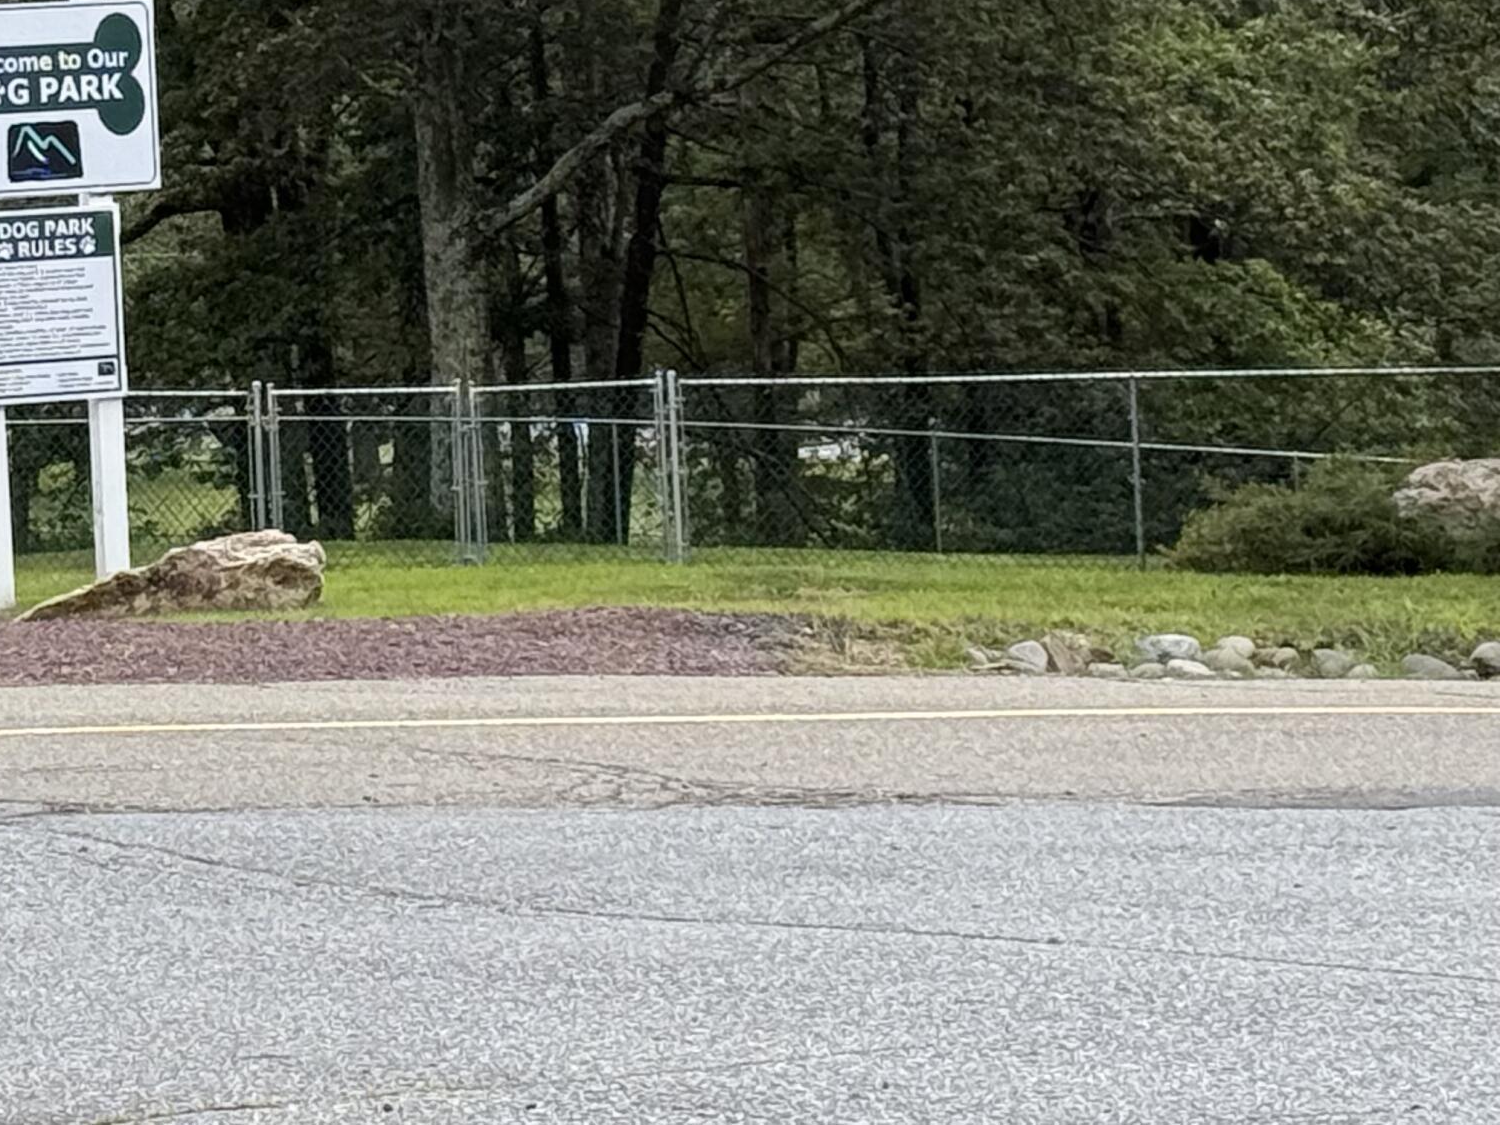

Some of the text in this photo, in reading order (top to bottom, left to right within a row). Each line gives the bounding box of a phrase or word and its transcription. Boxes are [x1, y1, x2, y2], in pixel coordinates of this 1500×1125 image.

[58, 51, 81, 70] to
[87, 48, 129, 68] Our
[39, 73, 124, 103] PARK
[0, 217, 94, 240] DOG PARK
[17, 238, 77, 258] RULES
